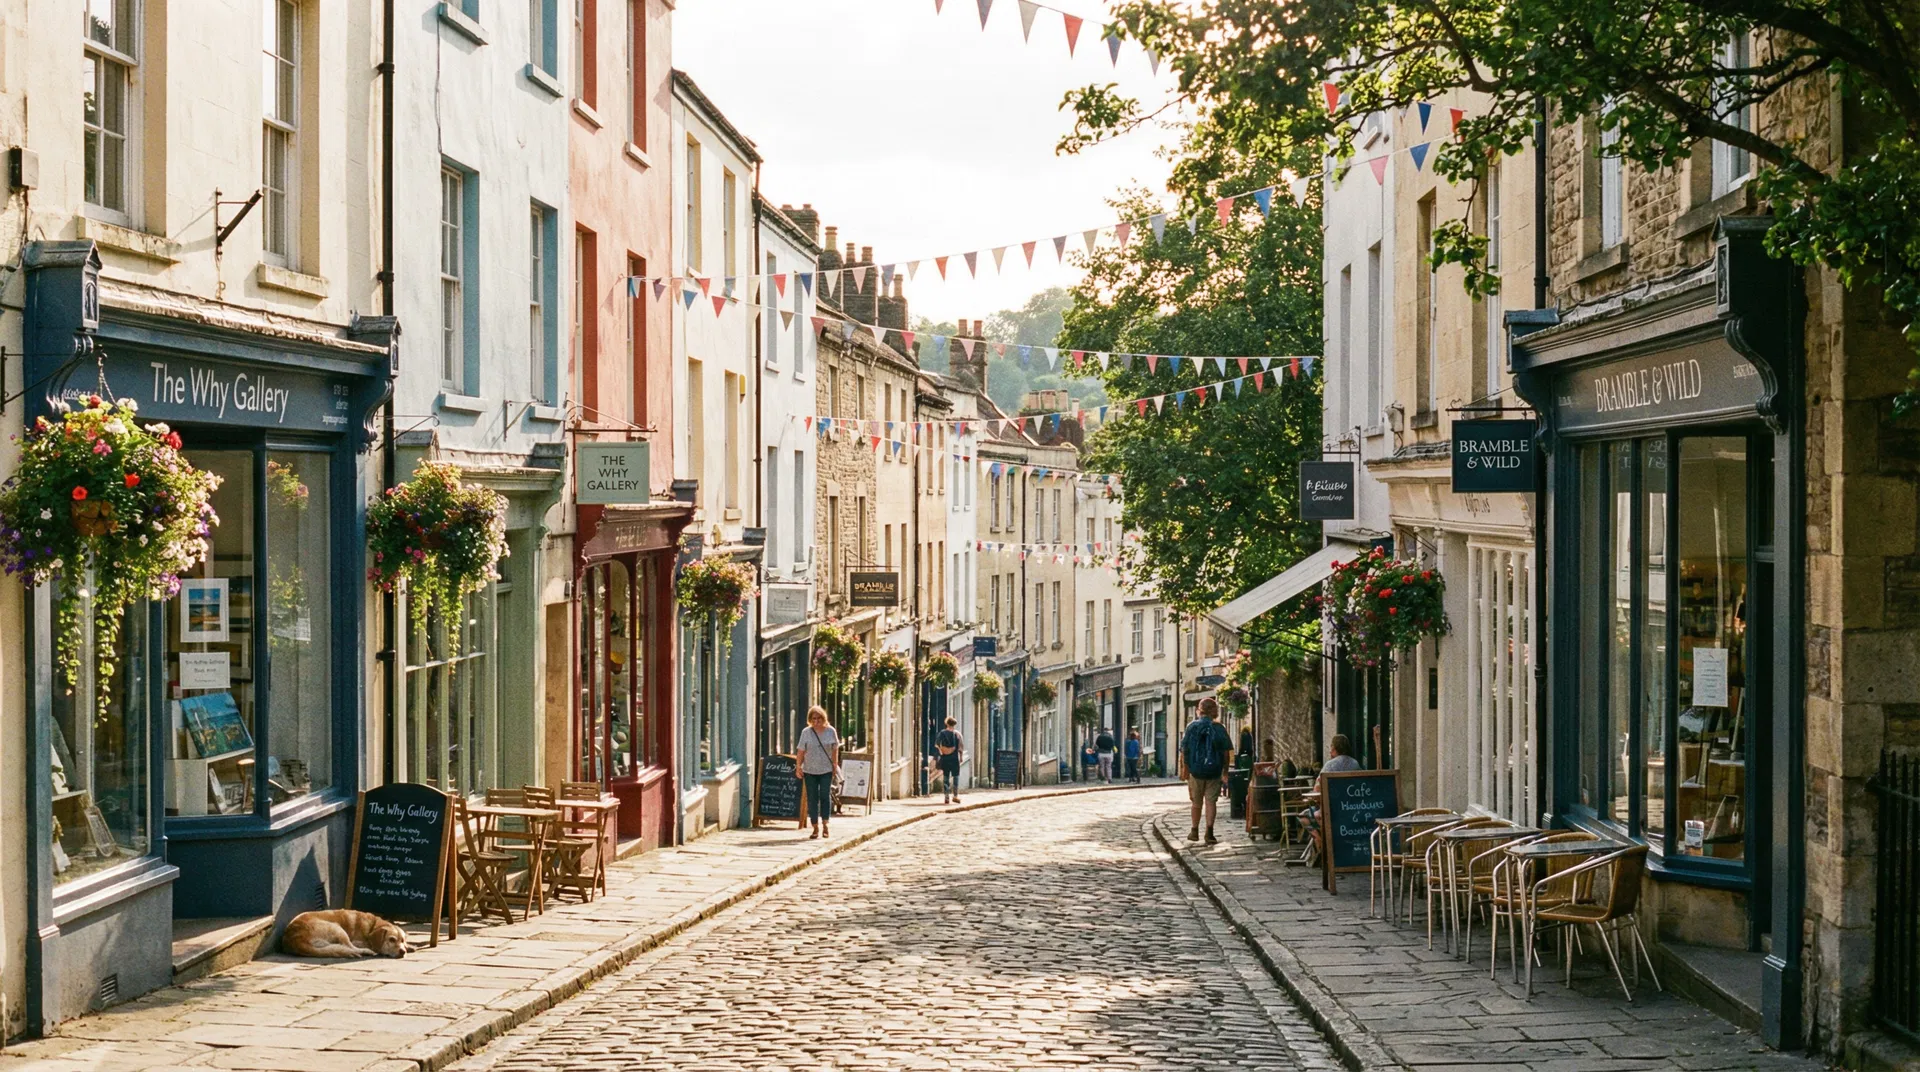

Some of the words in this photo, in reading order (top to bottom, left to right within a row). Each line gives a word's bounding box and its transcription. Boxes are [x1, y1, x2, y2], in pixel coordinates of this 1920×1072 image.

[151, 362, 185, 404] The
[190, 367, 229, 418] Why
[234, 373, 289, 423] Gallery
[1594, 368, 1651, 413] BRAMBLE
[1652, 367, 1663, 404] &
[1663, 359, 1702, 401] WILD
[1460, 440, 1529, 453] BRAMBLE
[602, 456, 625, 465] THE
[1467, 457, 1478, 469] &
[1481, 456, 1520, 469] WILD
[598, 468, 628, 478] WHY
[587, 481, 639, 491] GALLERY
[1346, 782, 1372, 797] Cafe
[369, 802, 384, 815] The
[387, 804, 406, 822] Why
[407, 804, 438, 824] Gallery
